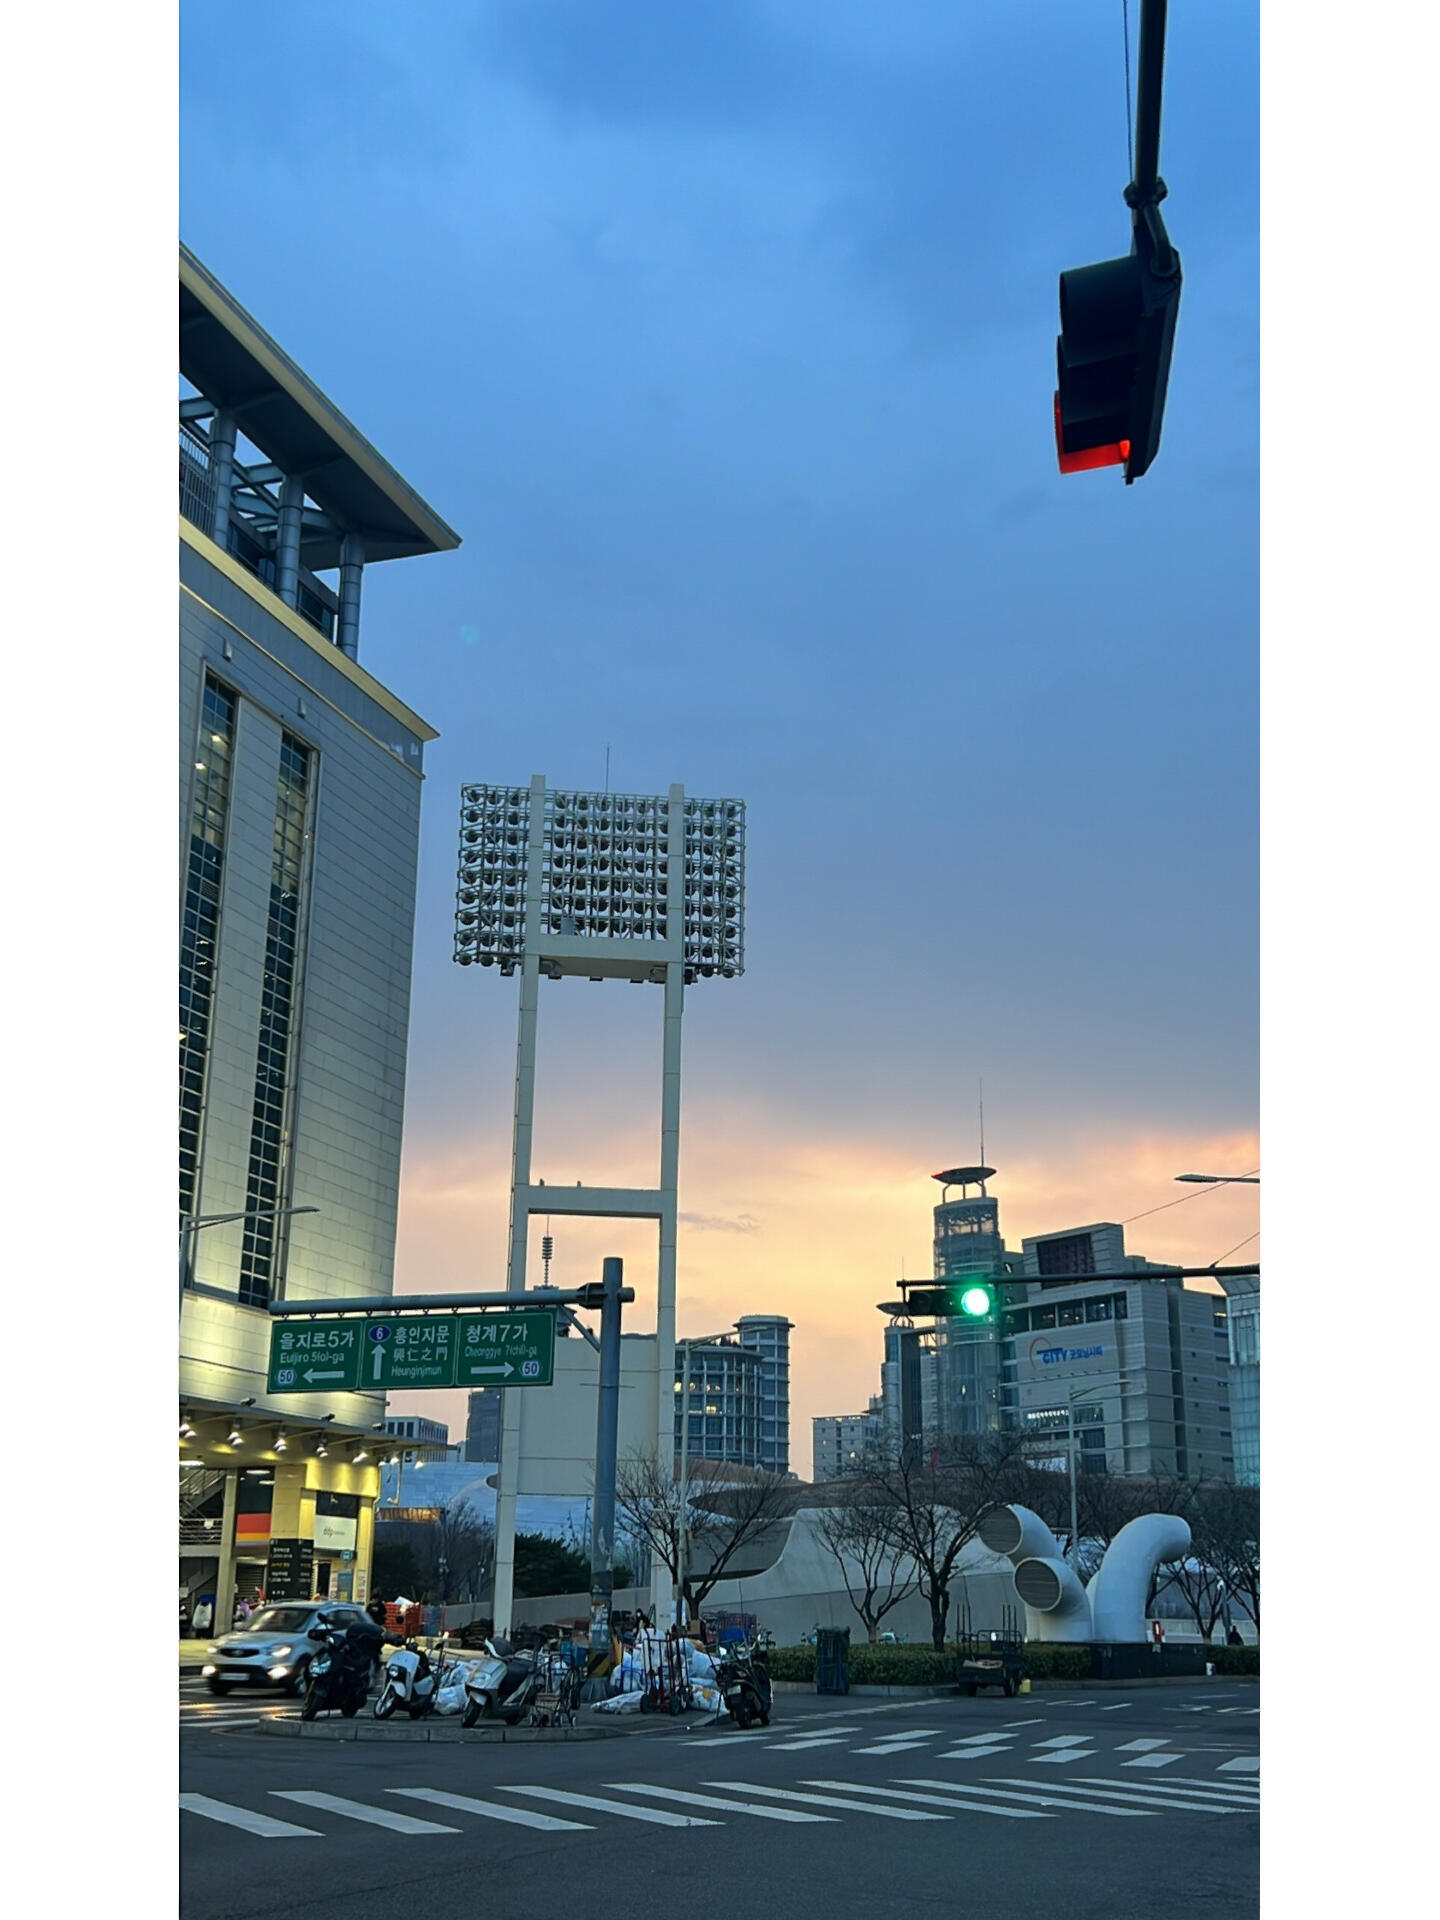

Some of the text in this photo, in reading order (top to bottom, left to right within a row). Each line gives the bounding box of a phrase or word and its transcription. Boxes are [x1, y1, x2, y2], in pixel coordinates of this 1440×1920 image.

[280, 1330, 354, 1350] 을지로5가
[376, 1327, 384, 1340] 6
[395, 1326, 449, 1344] 흥인지문
[466, 1322, 528, 1343] 청계7가
[1043, 1349, 1067, 1364] CITY
[523, 1362, 538, 1374] 50
[279, 1370, 294, 1383] 50
